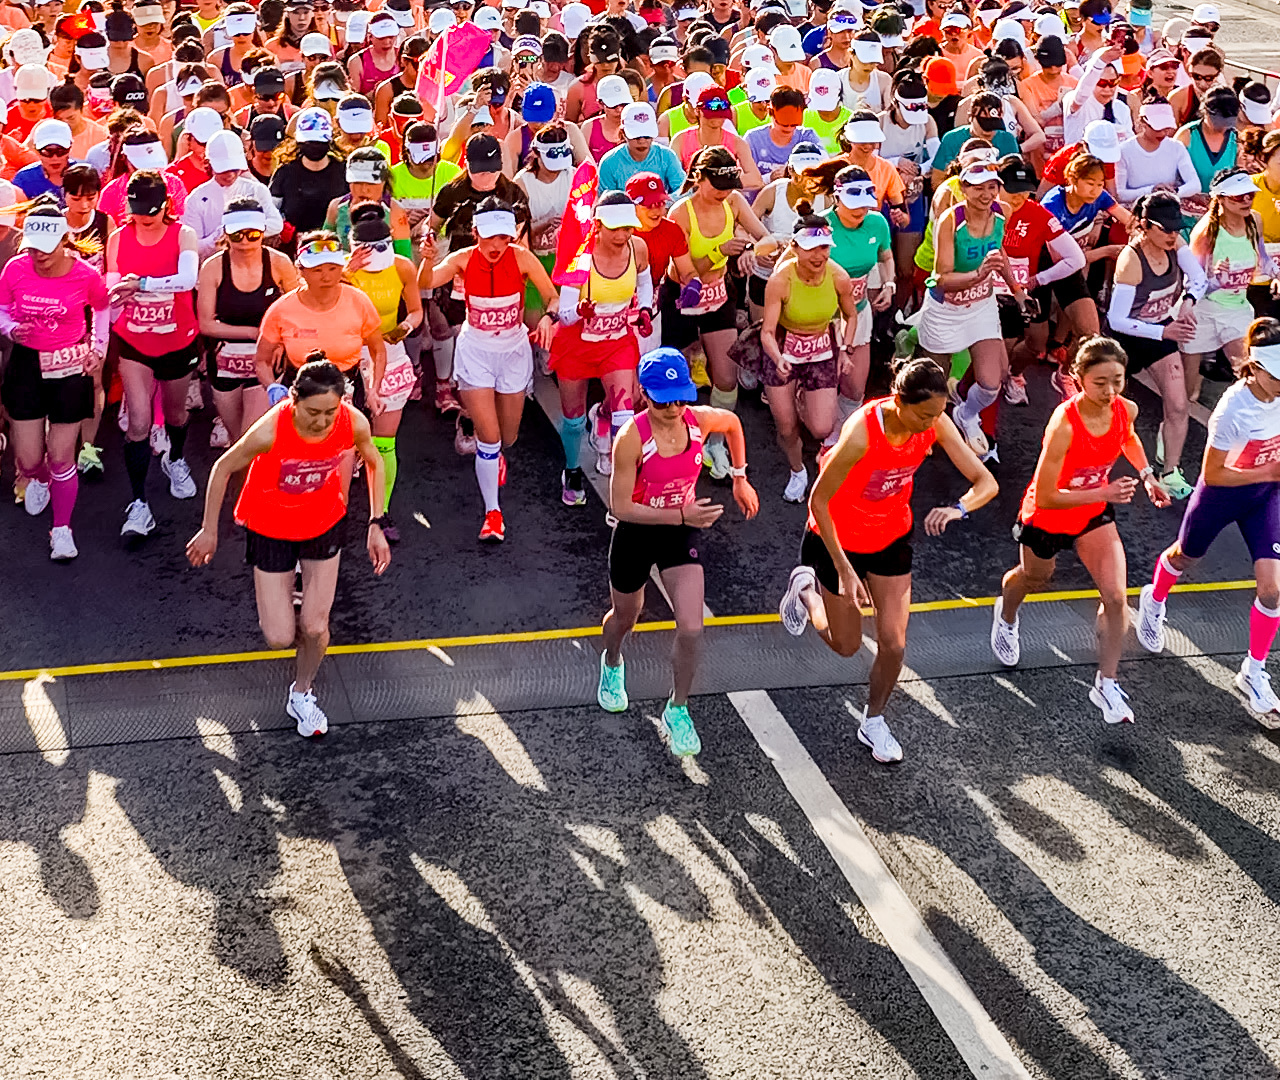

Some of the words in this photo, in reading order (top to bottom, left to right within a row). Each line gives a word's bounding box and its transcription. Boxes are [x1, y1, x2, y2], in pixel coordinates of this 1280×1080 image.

[954, 281, 990, 302] A2685
[132, 304, 173, 322] A2347
[479, 307, 519, 327] A2349
